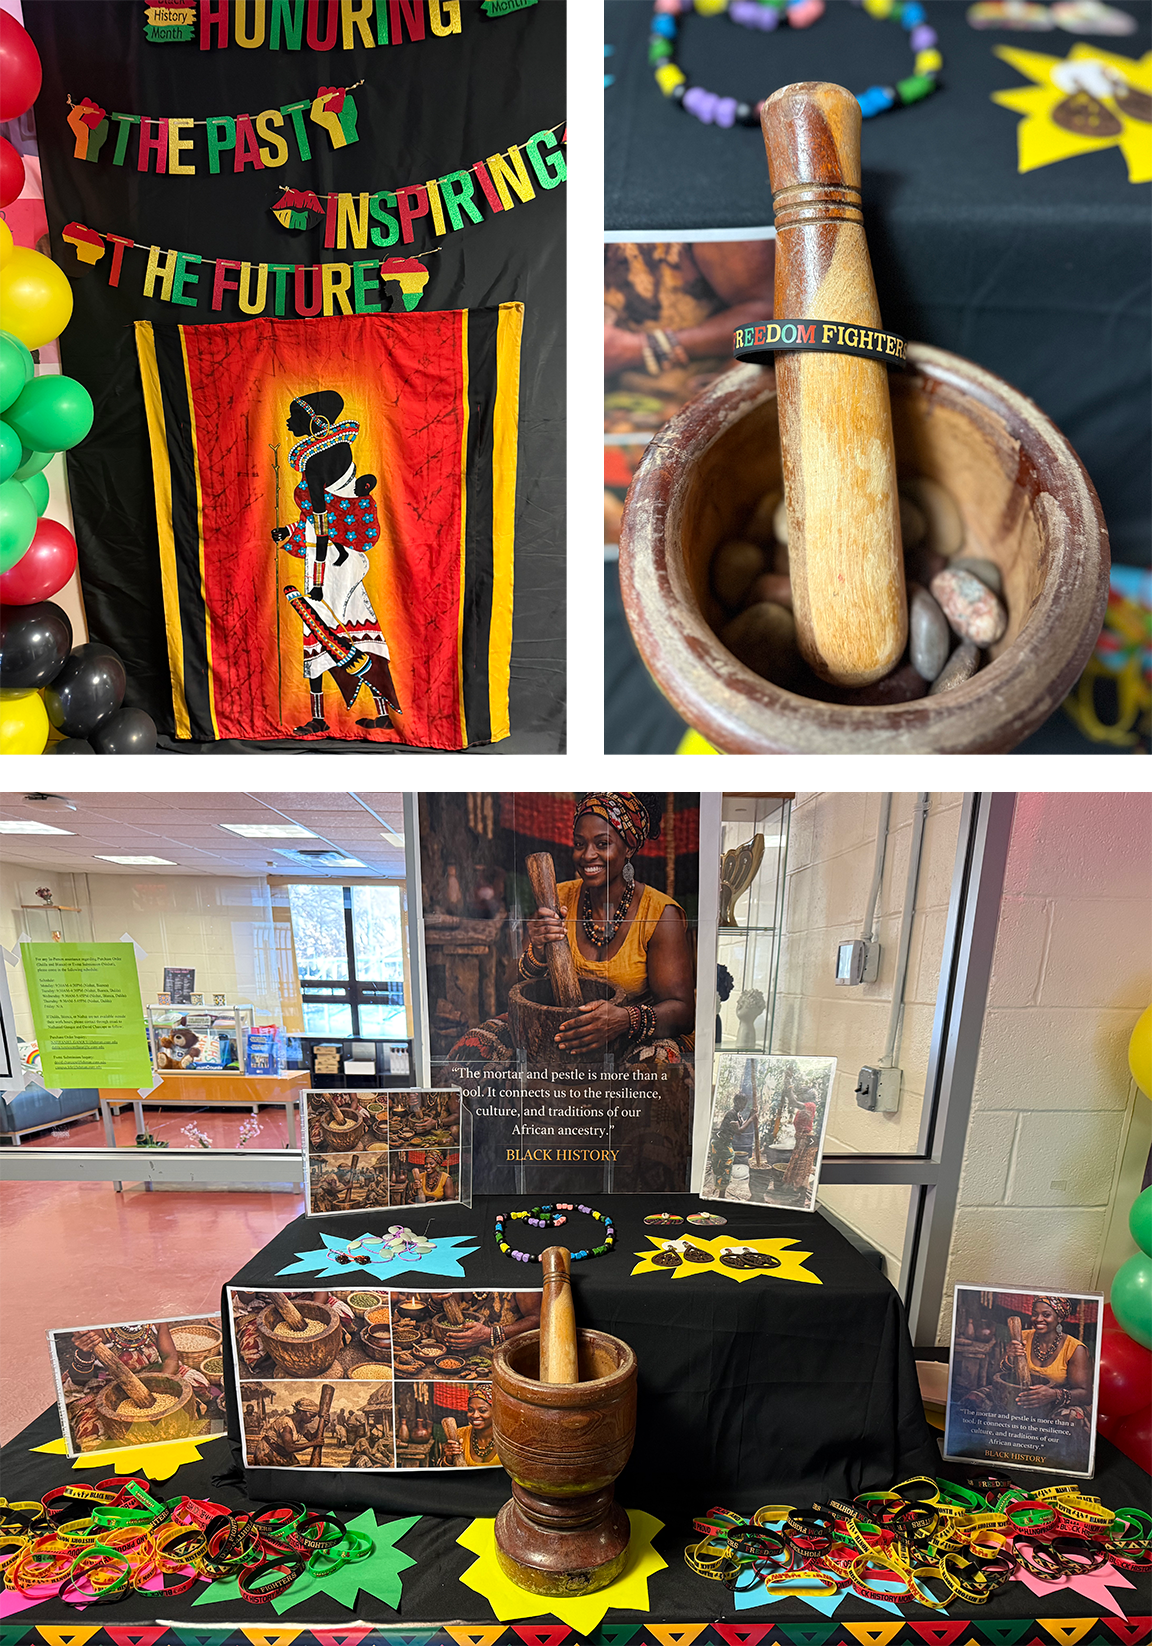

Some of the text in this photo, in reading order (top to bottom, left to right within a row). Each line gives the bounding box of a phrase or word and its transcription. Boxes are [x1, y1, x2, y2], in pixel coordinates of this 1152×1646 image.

[154, 9, 188, 25] History
[151, 26, 183, 39] Month
[200, 0, 462, 51] HONORING
[111, 111, 196, 175] THE
[205, 99, 311, 174] PAST
[323, 128, 567, 250] INSPIRING
[211, 258, 381, 318] FUTURE
[733, 323, 908, 361] REEDOM FIGHTERS
[451, 1067, 668, 1083] “The mortar and pestle is more than a
[461, 1087, 662, 1101] ool. It connects us to the resilience,
[475, 1106, 642, 1119] culture, and traditions of our
[511, 1124, 615, 1138] African ancestry.”
[506, 1149, 620, 1162] BLACK HISTORY
[976, 1410, 997, 1419] mortar
[997, 1412, 1010, 1420] and
[1010, 1413, 1029, 1423] pestle
[1030, 1414, 1036, 1422] is
[1037, 1417, 1053, 1425] more
[1054, 1417, 1070, 1426] than
[971, 1427, 994, 1436] culture,
[995, 1430, 1008, 1438] and
[1008, 1431, 1039, 1441] traditions
[1039, 1434, 1047, 1442] of
[983, 1420, 1010, 1428] connects
[1039, 1425, 1071, 1436] resilience,
[989, 1438, 1012, 1447] African
[985, 1449, 1047, 1463] BLACK HISTORY
[938, 1507, 953, 1515] ONTH
[787, 1517, 807, 1534] FIGHTE
[260, 1571, 297, 1593] FIGHTERS
[870, 1591, 898, 1603] HISTORY
[898, 1595, 914, 1603] MON
